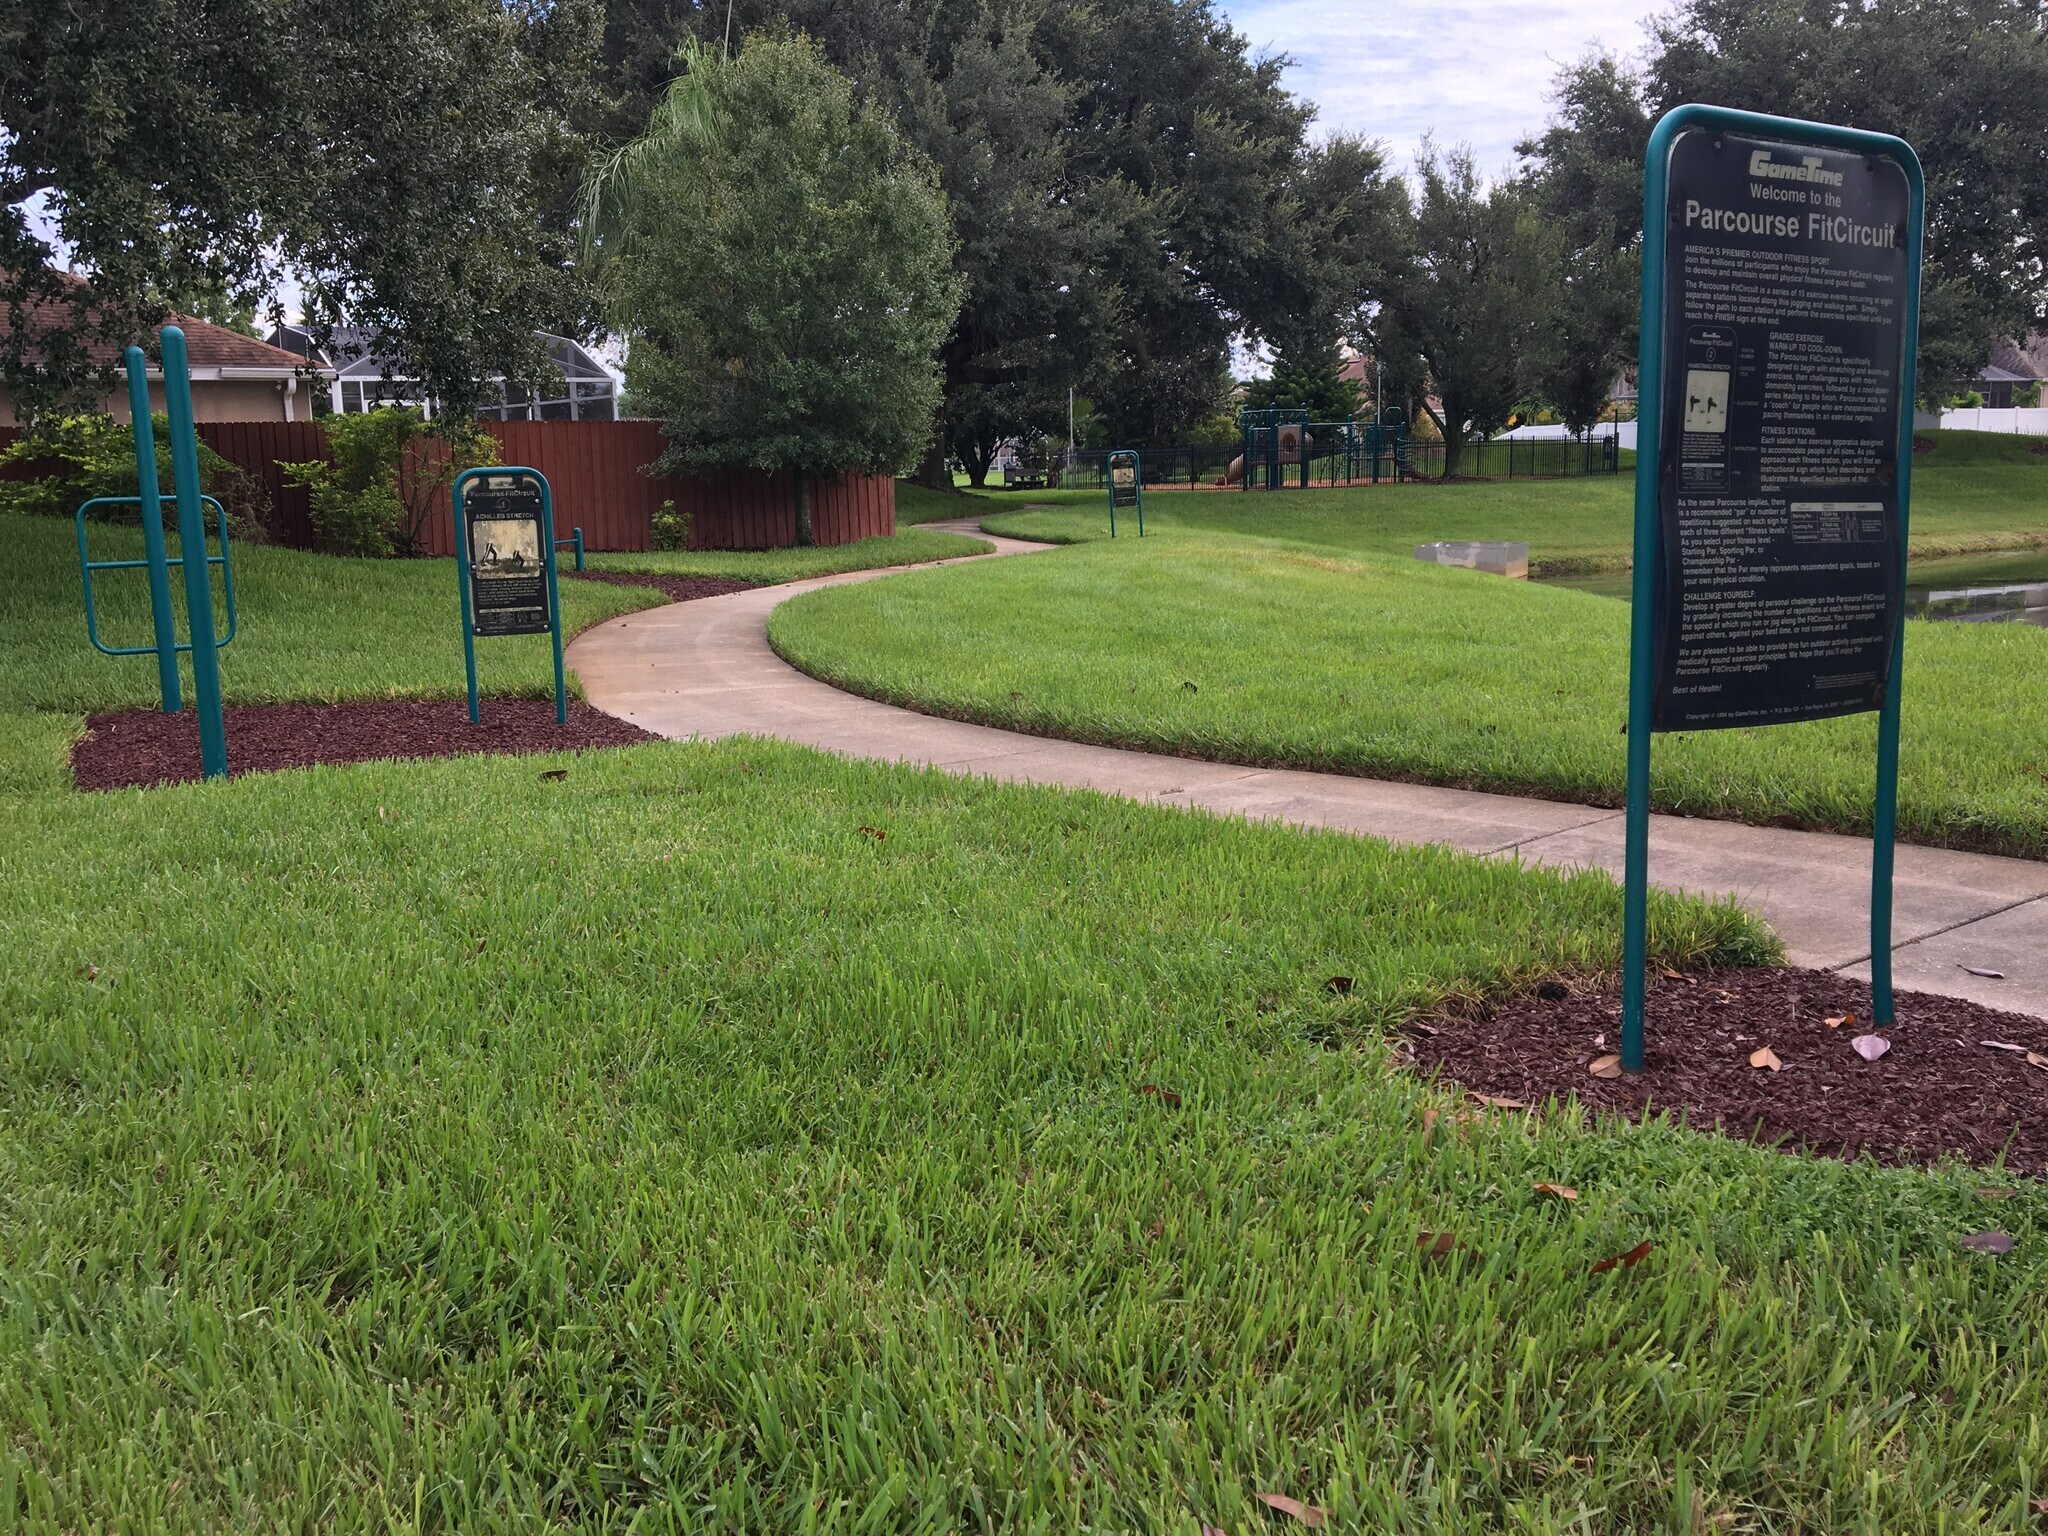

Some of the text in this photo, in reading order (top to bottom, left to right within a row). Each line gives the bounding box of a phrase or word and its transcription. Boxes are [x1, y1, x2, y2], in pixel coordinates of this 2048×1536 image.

[1750, 150, 1843, 186] GameTime
[1750, 183, 1842, 208] Welcome to the
[1686, 200, 1895, 248] Parcourse FitCircuit
[1685, 245, 1830, 265] AMERICA'S PREMIER OUTDOOR FITNESS SPORT
[1685, 255, 1698, 263] Join
[1712, 258, 1735, 267] millions
[1745, 261, 1779, 271] participants
[1693, 267, 1823, 284] develop maintain overall physical fitness
[1698, 281, 1729, 291] Parcourse
[1731, 284, 1758, 293] FitCircuit
[1686, 292, 1811, 309] separate stations located jogging
[1685, 300, 1703, 308] follow
[1716, 303, 1730, 311] path
[1787, 309, 1808, 317] perform
[1715, 313, 1735, 321] FINISH
[1736, 315, 1749, 324] sign
[1770, 332, 1794, 341] GRADED
[1769, 342, 1797, 351] WARM-UP
[1780, 353, 1834, 363] Parcourse FitCircuit
[1767, 362, 1792, 371] designed
[1810, 375, 1838, 384] challenges
[1765, 382, 1796, 392] demanding
[1783, 392, 1803, 401] leading
[1802, 403, 1820, 411] people
[1763, 411, 1782, 420] pacing
[1807, 448, 1825, 456] people
[1761, 456, 1786, 464] approach
[1680, 519, 1710, 527] repetitions
[1712, 519, 1742, 527] suggested
[1682, 546, 1744, 557] Starting Sporting
[1683, 558, 1724, 566] Championship
[1683, 567, 1712, 575] remember
[1750, 565, 1768, 573] merely
[1801, 563, 1838, 571] recommended
[1713, 576, 1737, 585] physical
[1684, 592, 1721, 601] CHALLENGE
[1684, 603, 1708, 612] Develop
[1715, 602, 1736, 610] greater
[1737, 601, 1757, 609] degree
[1766, 599, 1789, 608] personal
[1693, 612, 1720, 622] gradually
[1722, 610, 1752, 619] increasing
[1794, 606, 1821, 615] repetitions
[1694, 623, 1712, 631] speed
[1721, 620, 1739, 629] which
[1681, 632, 1704, 642] against
[1729, 630, 1750, 639] against
[1812, 624, 1833, 632] compete
[1703, 639, 1830, 657] pleased provide outdoor
[1677, 657, 1709, 666] medically
[1711, 656, 1730, 664] sound
[1732, 654, 1757, 663] exercise
[1825, 648, 1838, 657] you'll
[1712, 665, 1741, 673] FitCircuit
[1673, 686, 1688, 694] Best
[1698, 684, 1722, 693] Health!
